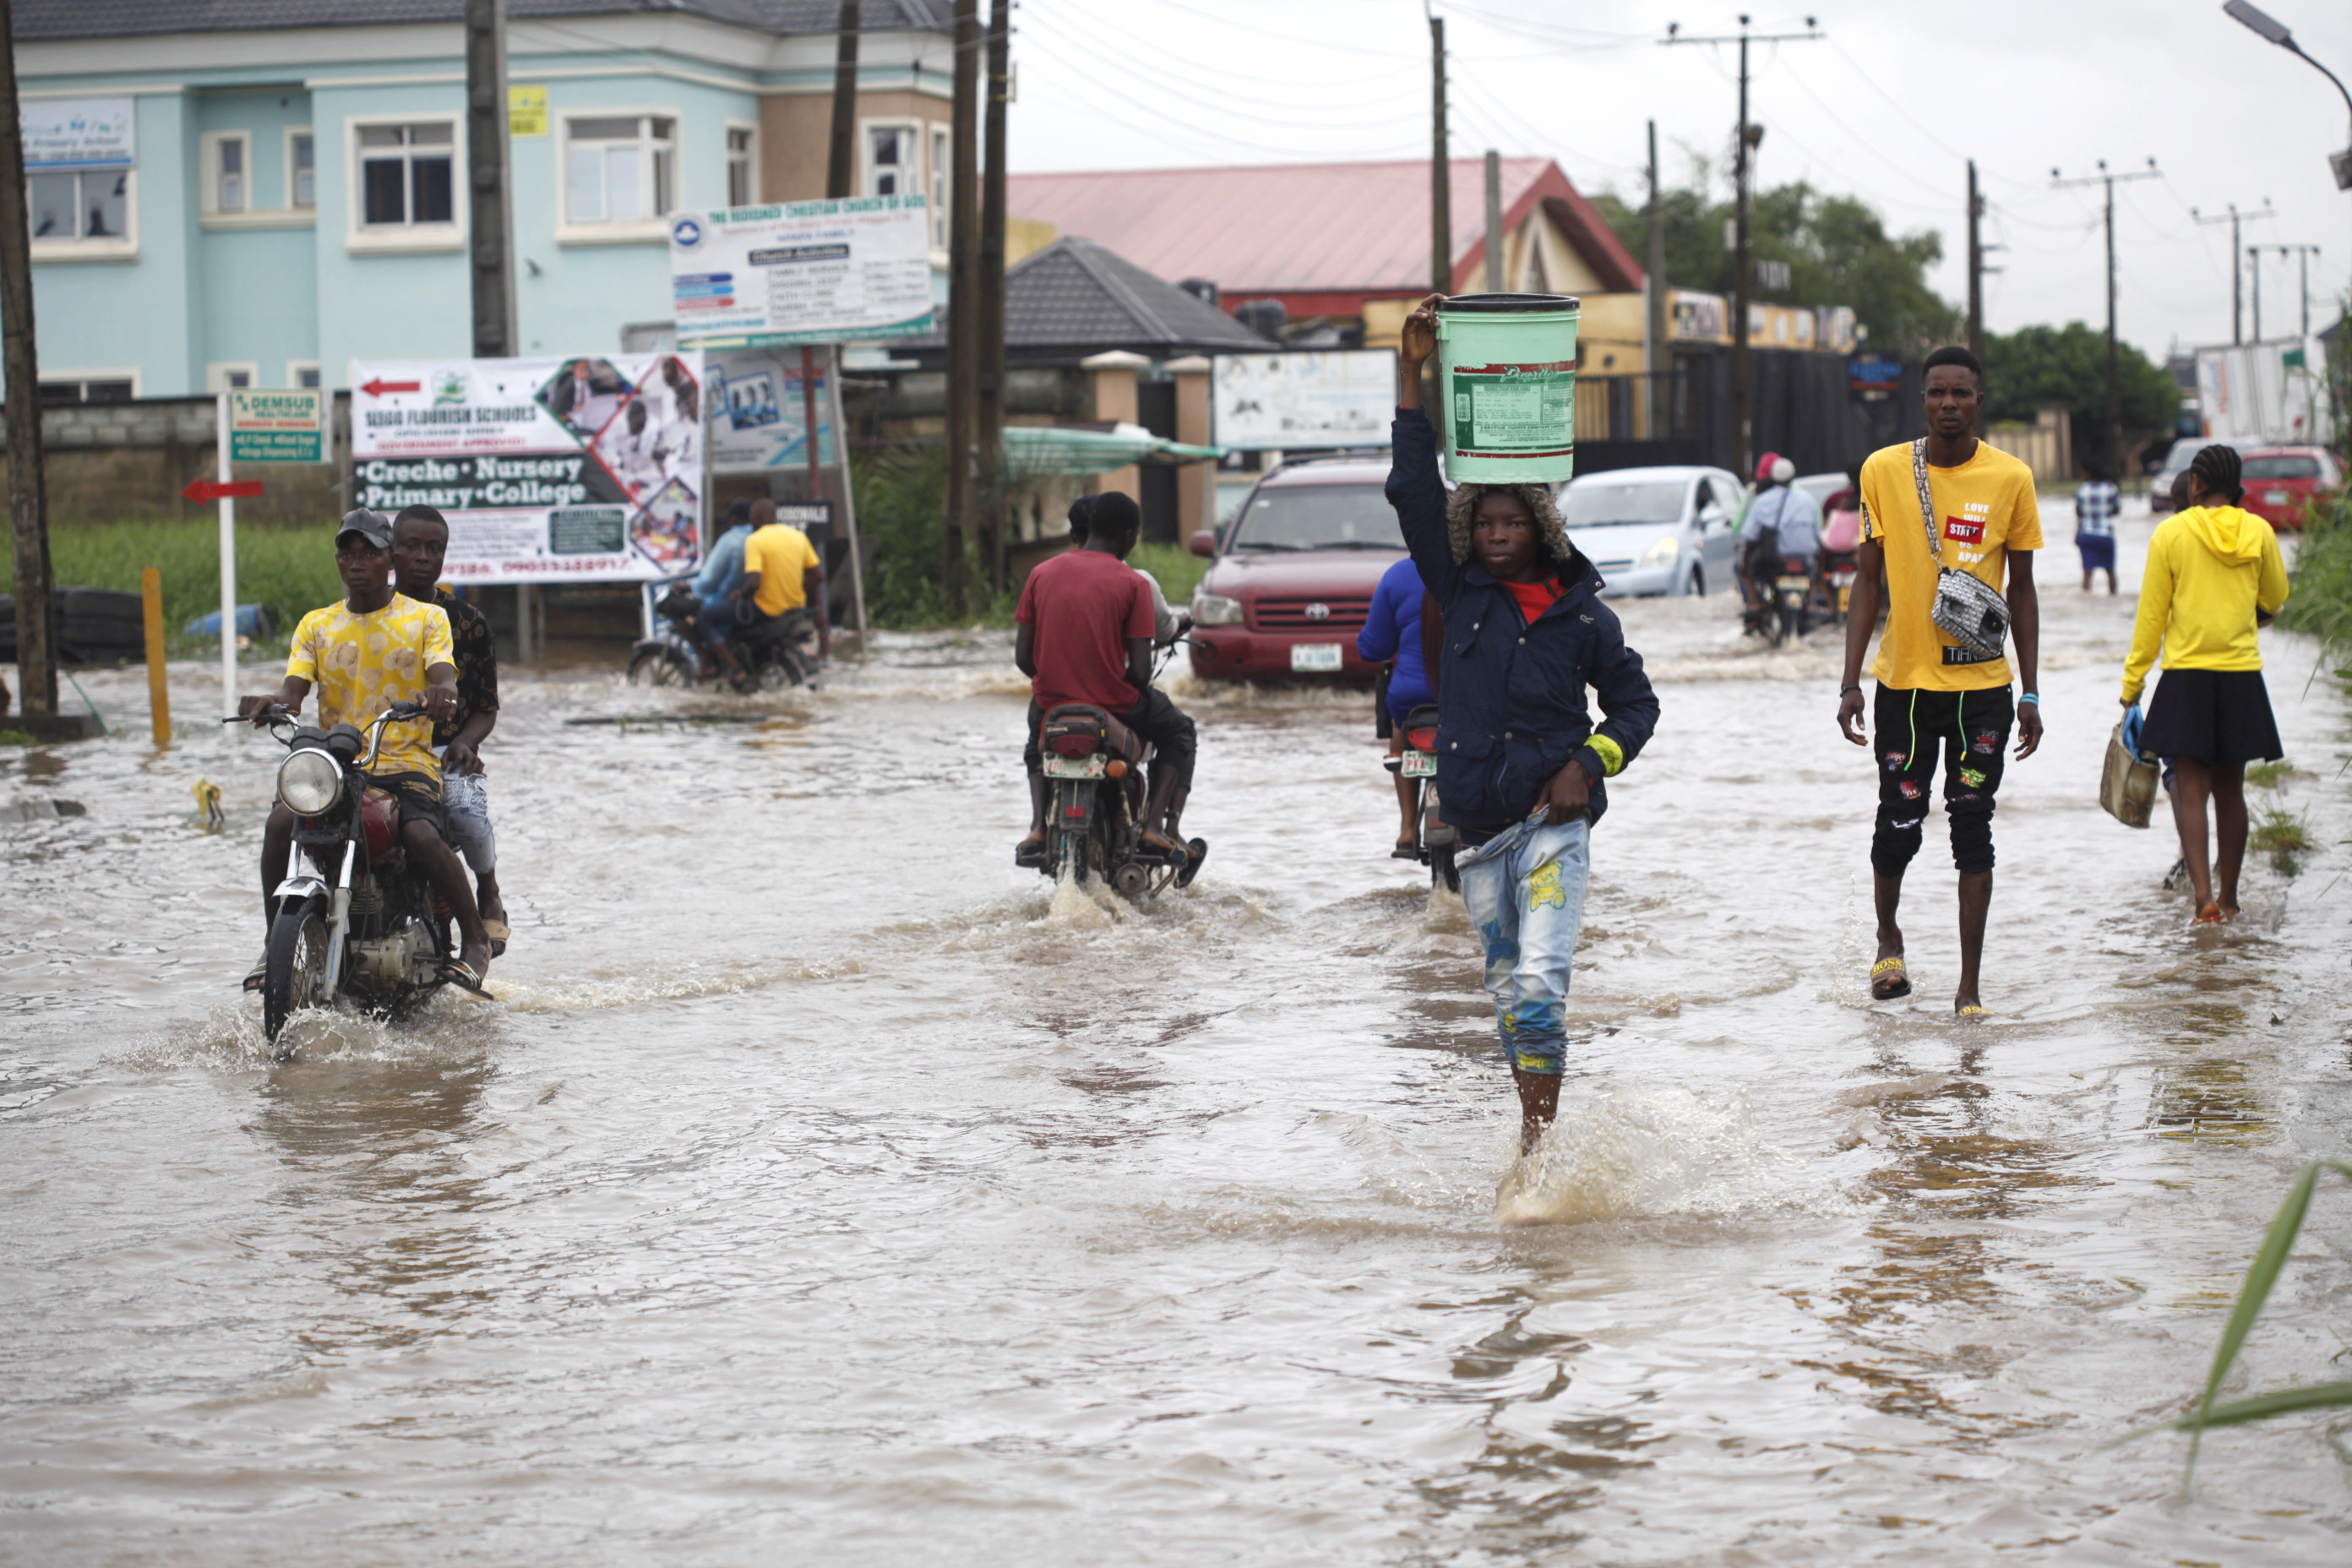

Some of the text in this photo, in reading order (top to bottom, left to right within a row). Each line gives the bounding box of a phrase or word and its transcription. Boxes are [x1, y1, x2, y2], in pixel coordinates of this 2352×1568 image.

[841, 198, 883, 214] CHURCH
[886, 197, 900, 210] OF
[903, 194, 927, 209] GOD
[1500, 365, 1560, 384] Prestige
[252, 395, 315, 409] DEMSUB
[253, 411, 311, 419] HEALTHCARE
[407, 407, 471, 425] FLOURISH
[476, 405, 537, 423] SCHOOLS
[366, 456, 585, 484] Creche Nursery
[365, 480, 587, 510] Primary College
[1964, 502, 1990, 514] LOVE
